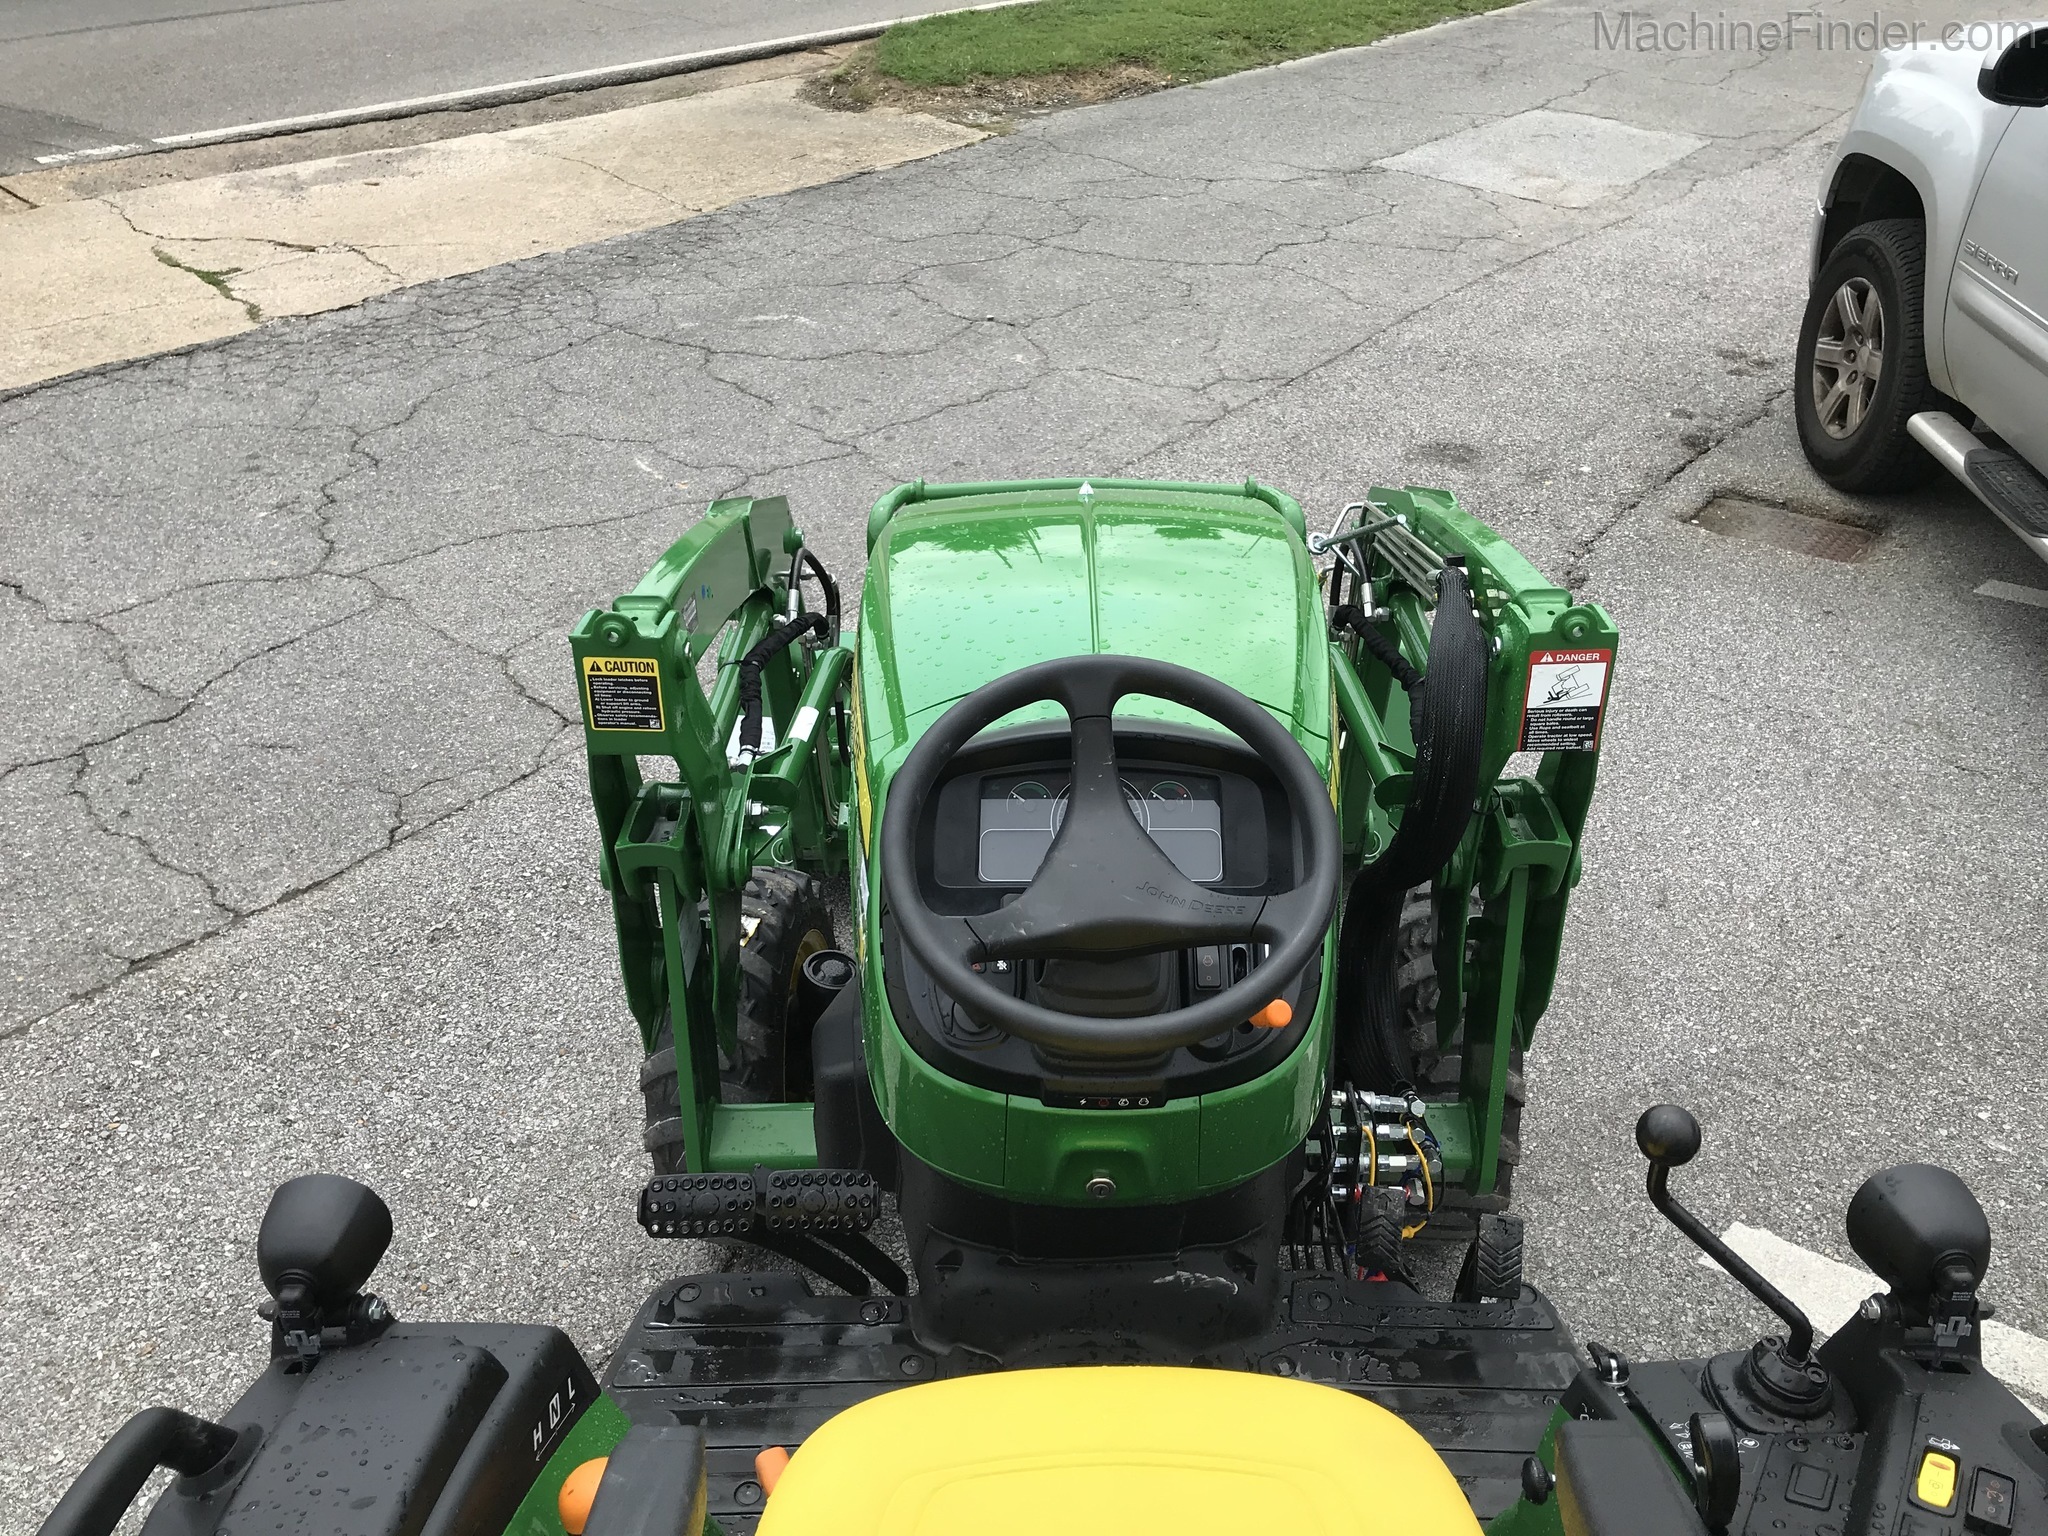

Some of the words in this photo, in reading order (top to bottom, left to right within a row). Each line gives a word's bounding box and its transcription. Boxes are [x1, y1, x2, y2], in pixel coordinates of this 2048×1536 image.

[1963, 238, 2019, 286] SIERRA
[604, 660, 654, 673] CAUTION
[1556, 652, 1600, 662] DANGER
[1136, 881, 1187, 909] JOHN
[1188, 899, 1246, 916] DEERE
[532, 1421, 542, 1451] H
[568, 1377, 576, 1400] L
